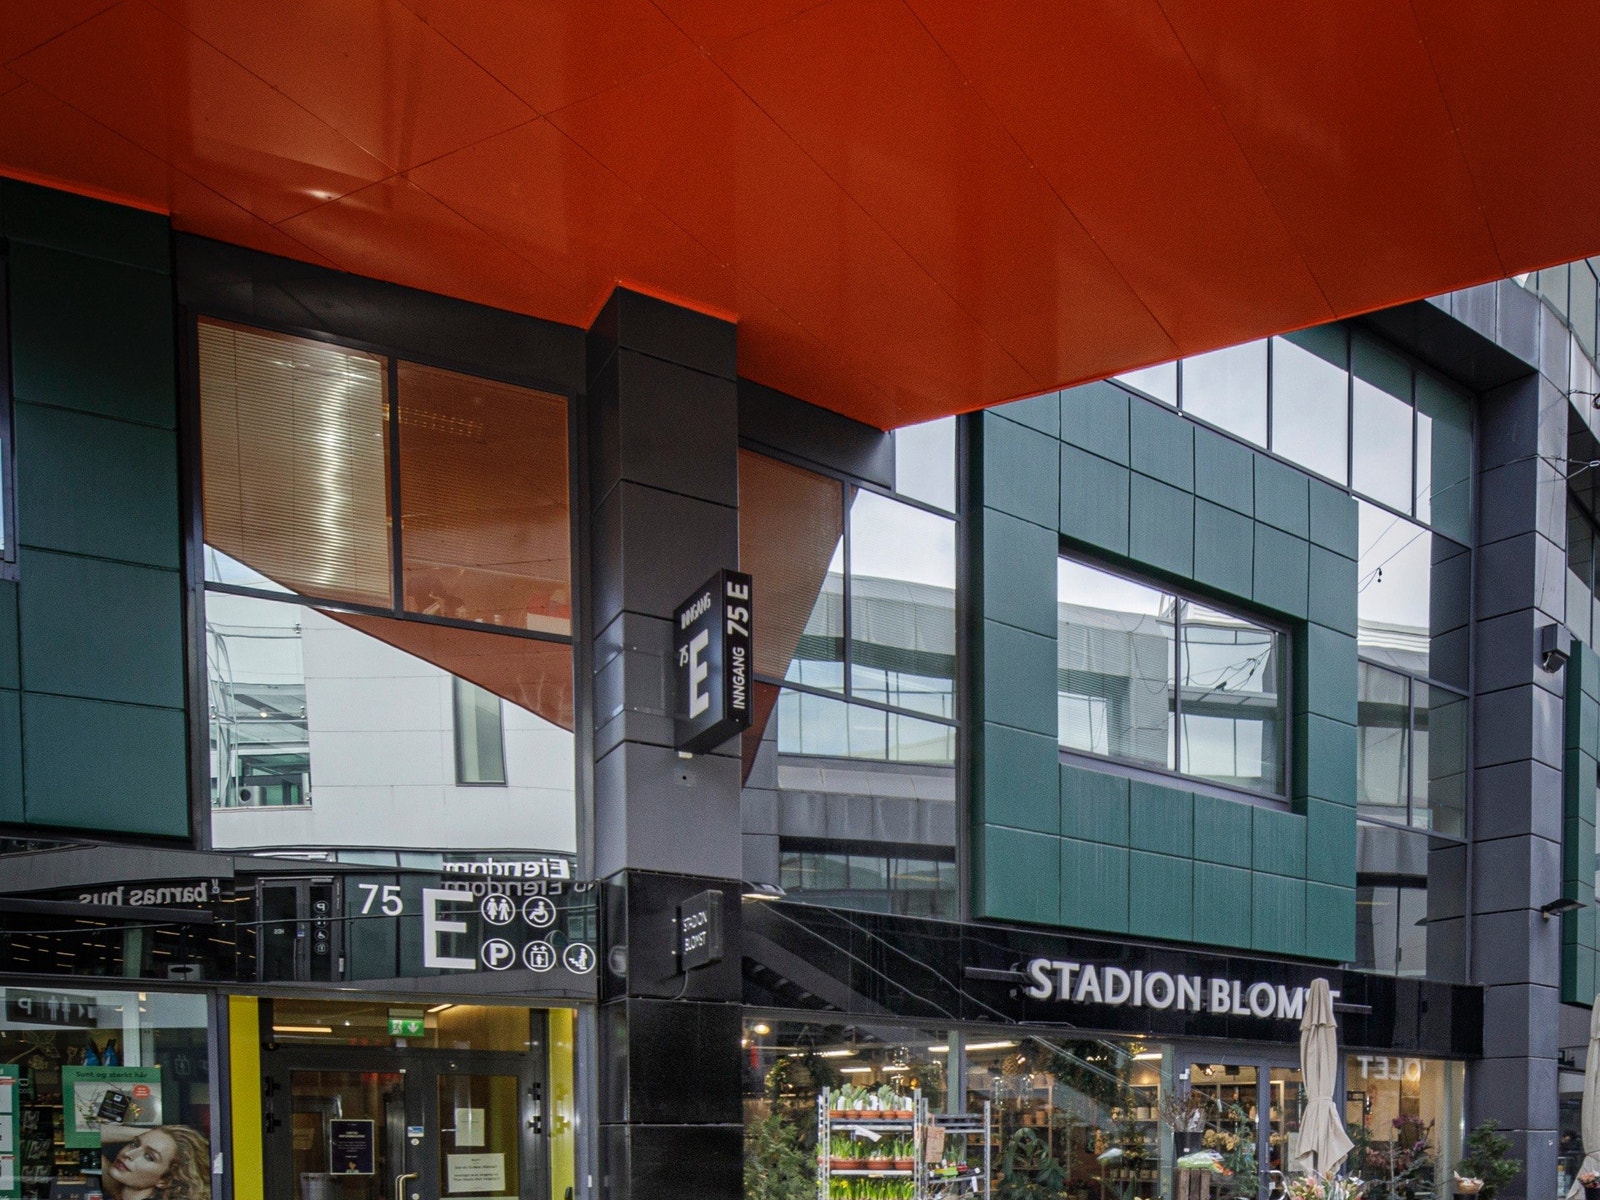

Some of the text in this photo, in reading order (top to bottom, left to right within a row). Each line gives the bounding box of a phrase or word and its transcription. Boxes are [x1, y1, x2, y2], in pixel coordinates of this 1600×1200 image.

[681, 591, 712, 631] INNGANG
[726, 581, 749, 710] INNGANG 75 E
[679, 629, 709, 719] 75 E
[358, 883, 403, 916] 75
[683, 912, 707, 932] STADION
[421, 888, 477, 970] E
[490, 943, 508, 965] P
[1026, 958, 1341, 1020] STADION BLOMT
